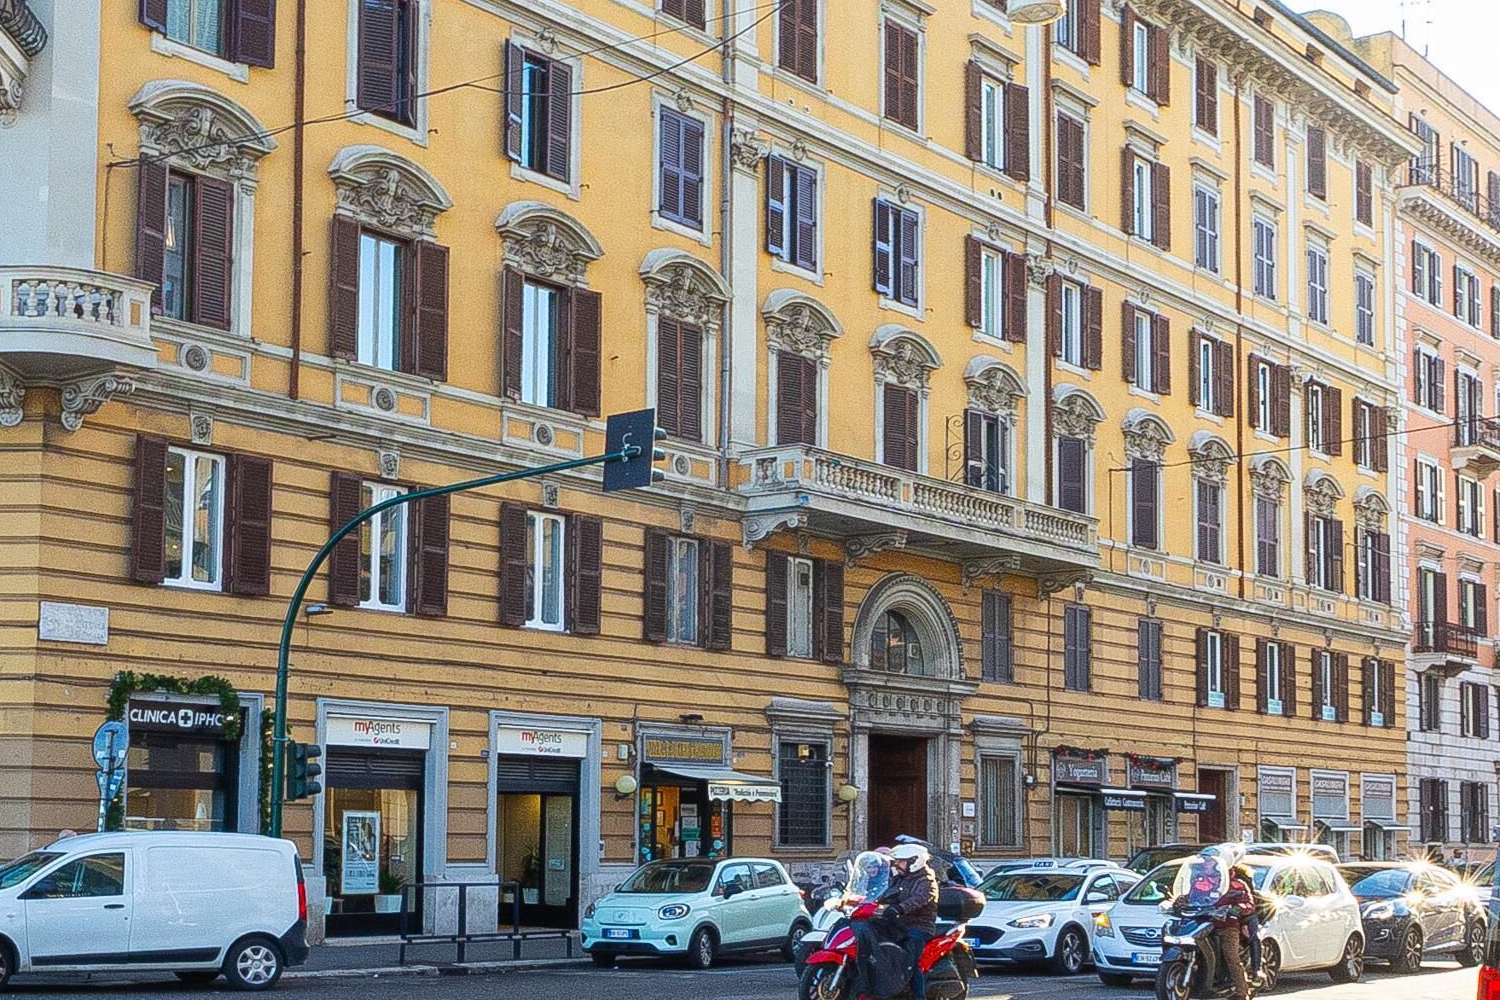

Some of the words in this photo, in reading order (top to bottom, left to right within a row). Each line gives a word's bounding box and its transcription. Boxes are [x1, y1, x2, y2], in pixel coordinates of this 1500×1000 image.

[130, 708, 177, 724] CLINICA
[194, 712, 223, 727] IPHO
[354, 721, 401, 735] myAgents
[521, 731, 562, 745] myAgents
